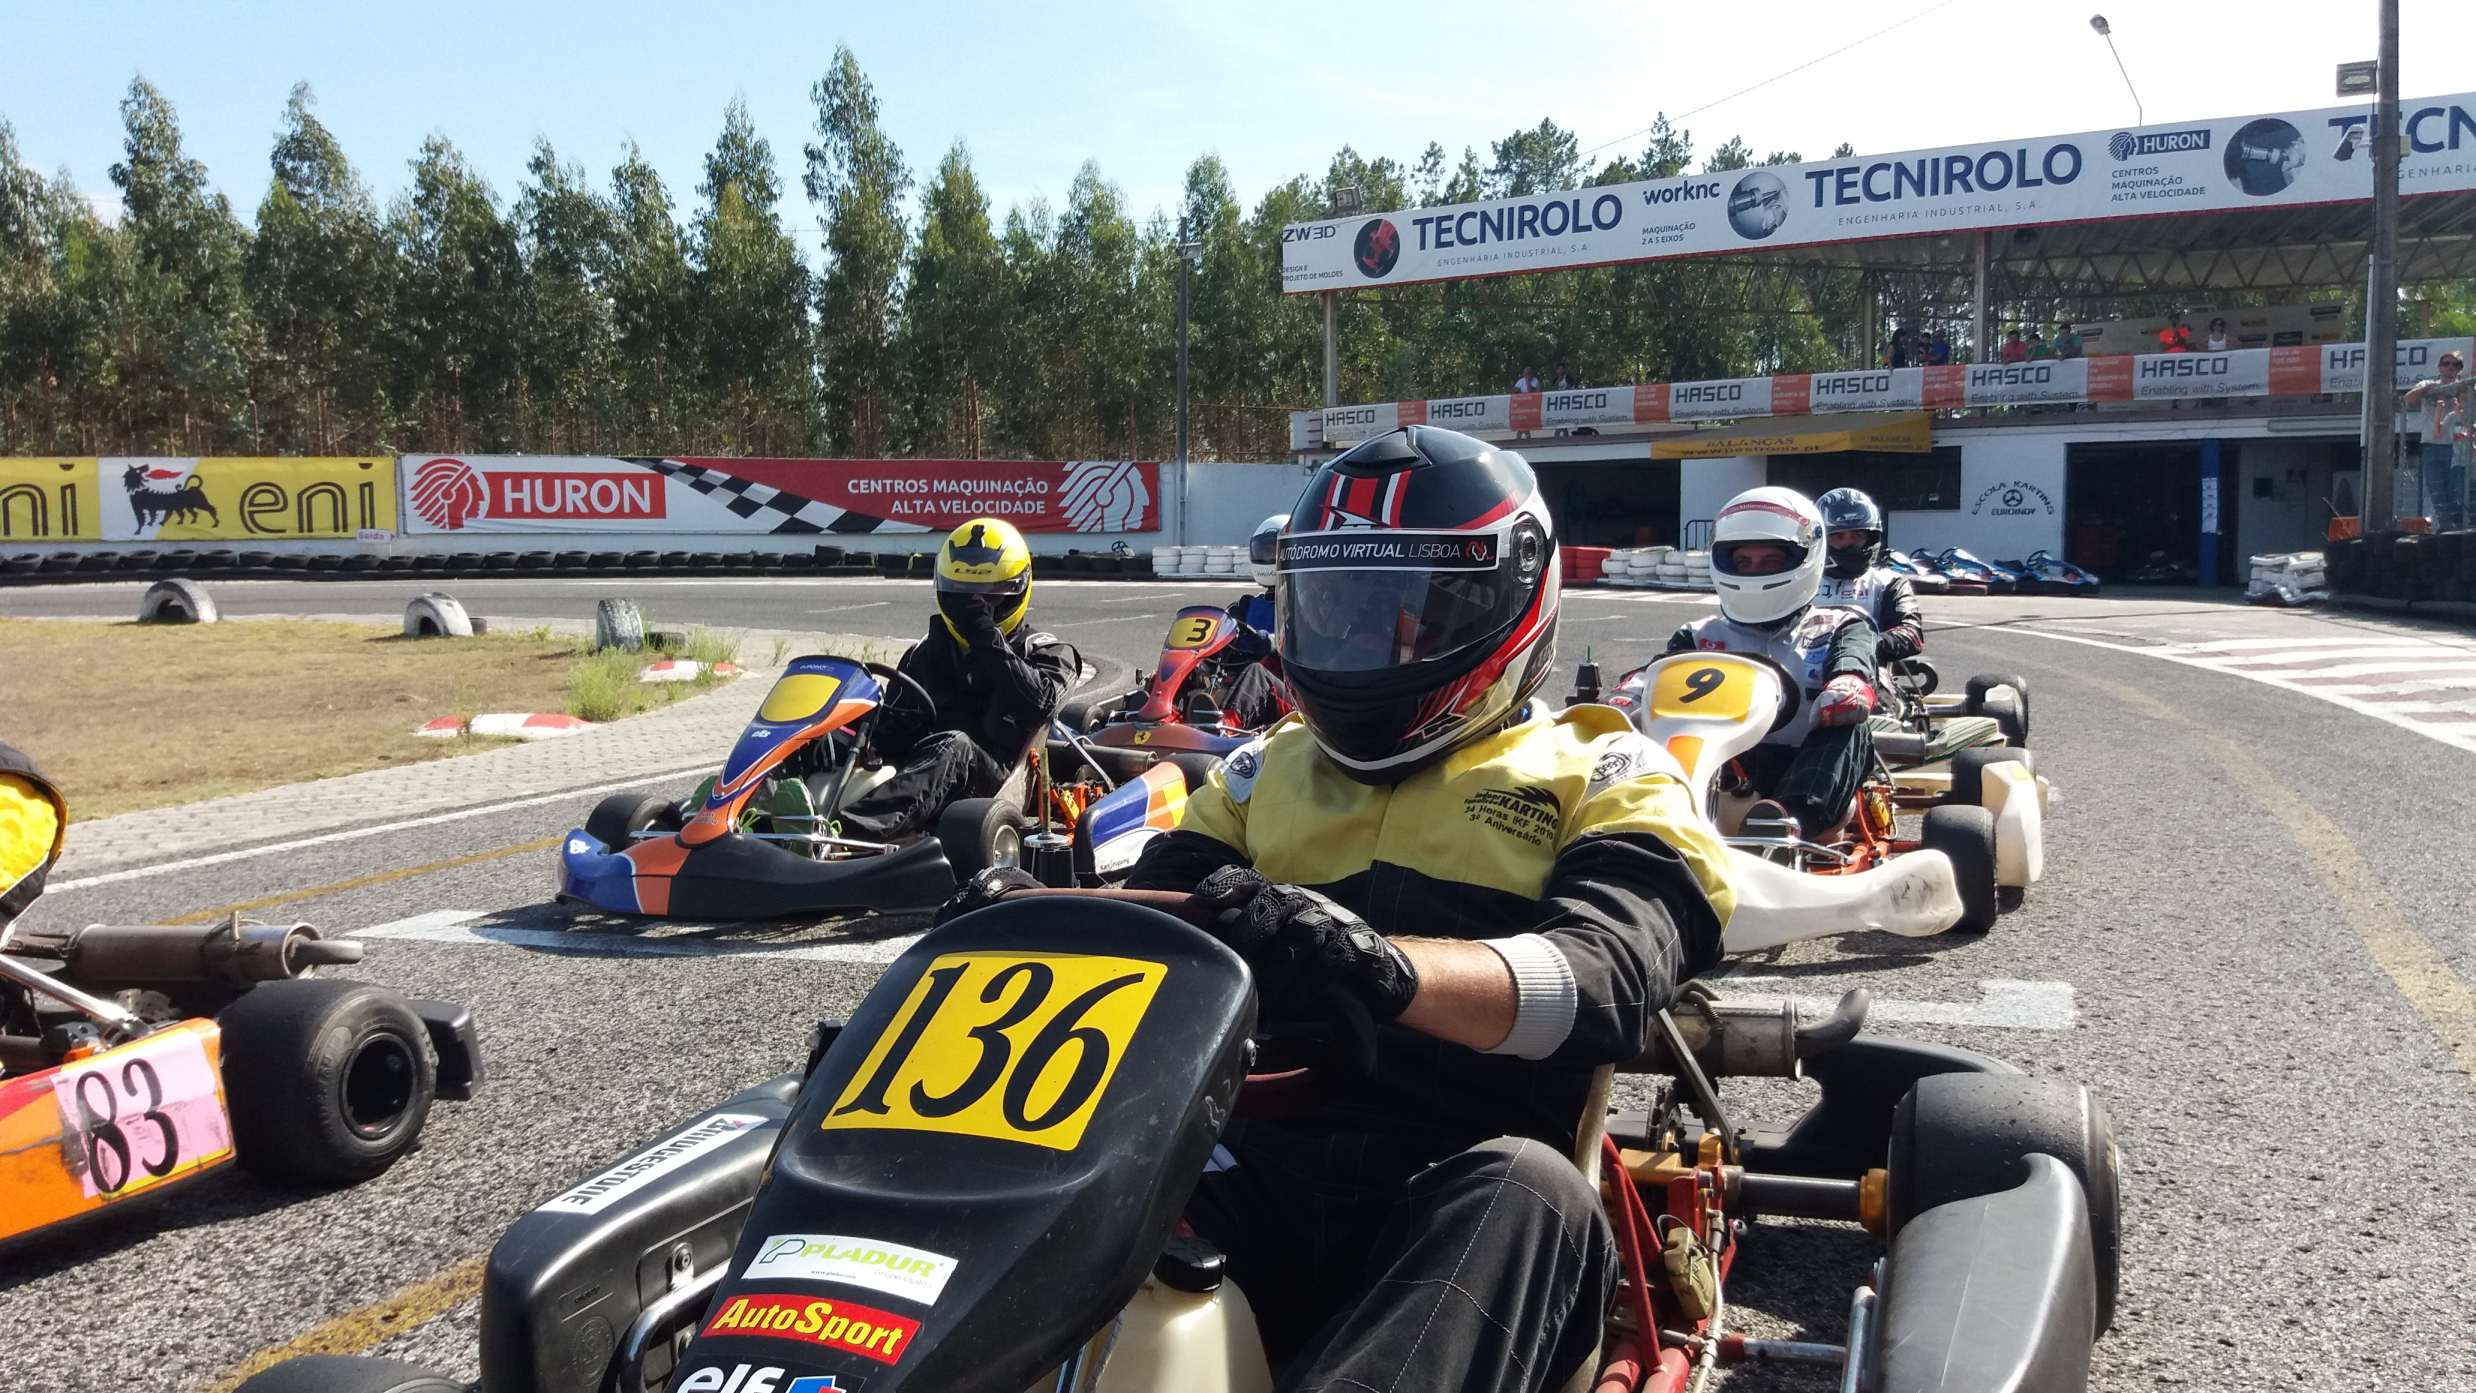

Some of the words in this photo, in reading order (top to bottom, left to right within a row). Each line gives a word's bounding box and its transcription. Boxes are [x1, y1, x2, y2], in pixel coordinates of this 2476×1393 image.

[2328, 105, 2476, 156] TCN
[2143, 132, 2205, 152] HURON
[1805, 143, 2082, 209] TECNIROLO
[2112, 166, 2159, 178] CENTROS
[1643, 180, 1720, 206] worknc
[2112, 176, 2183, 190] MAQUINAÇÃO
[2111, 191, 2137, 202] ALTA
[2139, 186, 2206, 200] VELOCIDADE
[1412, 194, 1623, 251] TECNIROLO
[1641, 221, 1696, 236] MAQUINAÇÃO
[1838, 211, 1919, 226] ENGENHARIA
[1660, 234, 1684, 244] EIXOS
[1437, 253, 1500, 267] ENGENHARIA
[1318, 270, 1344, 279] MOLDES
[1971, 366, 2050, 387] HASCO
[2141, 357, 2229, 379] HASCO
[1675, 385, 1742, 404] HASCO
[1816, 376, 1890, 396] HASCO
[2140, 385, 2188, 397] Enabling
[2192, 383, 2213, 394] with
[1431, 402, 1485, 419] HASCO
[1546, 393, 1607, 411] HASCO
[1325, 409, 1375, 427] HASCO
[503, 478, 651, 514] HURON
[847, 479, 929, 495] CENTROS
[933, 476, 1049, 497] MAQUINAÇÃO
[239, 462, 375, 534] eni
[890, 499, 936, 514] ALTA
[939, 499, 1046, 515] VELOCIDADE
[1971, 482, 2007, 516] ESCOLA
[2013, 480, 2054, 515] KARTING
[1279, 540, 1339, 561] AUTÓDROMO
[1342, 543, 1405, 558] VIRTUAL
[1408, 543, 1461, 559] LISBOA
[1186, 618, 1211, 642] 3
[1679, 667, 1725, 703] 9
[1479, 805, 1509, 821] Horas
[1498, 796, 1559, 830] KARTING
[833, 961, 1146, 1132] 136
[75, 1058, 179, 1193] 83
[560, 1117, 738, 1206] BRIDGESTONE
[800, 1243, 937, 1278] PLADUR
[711, 1298, 904, 1356] AutoSport
[676, 1363, 786, 1393] elf
